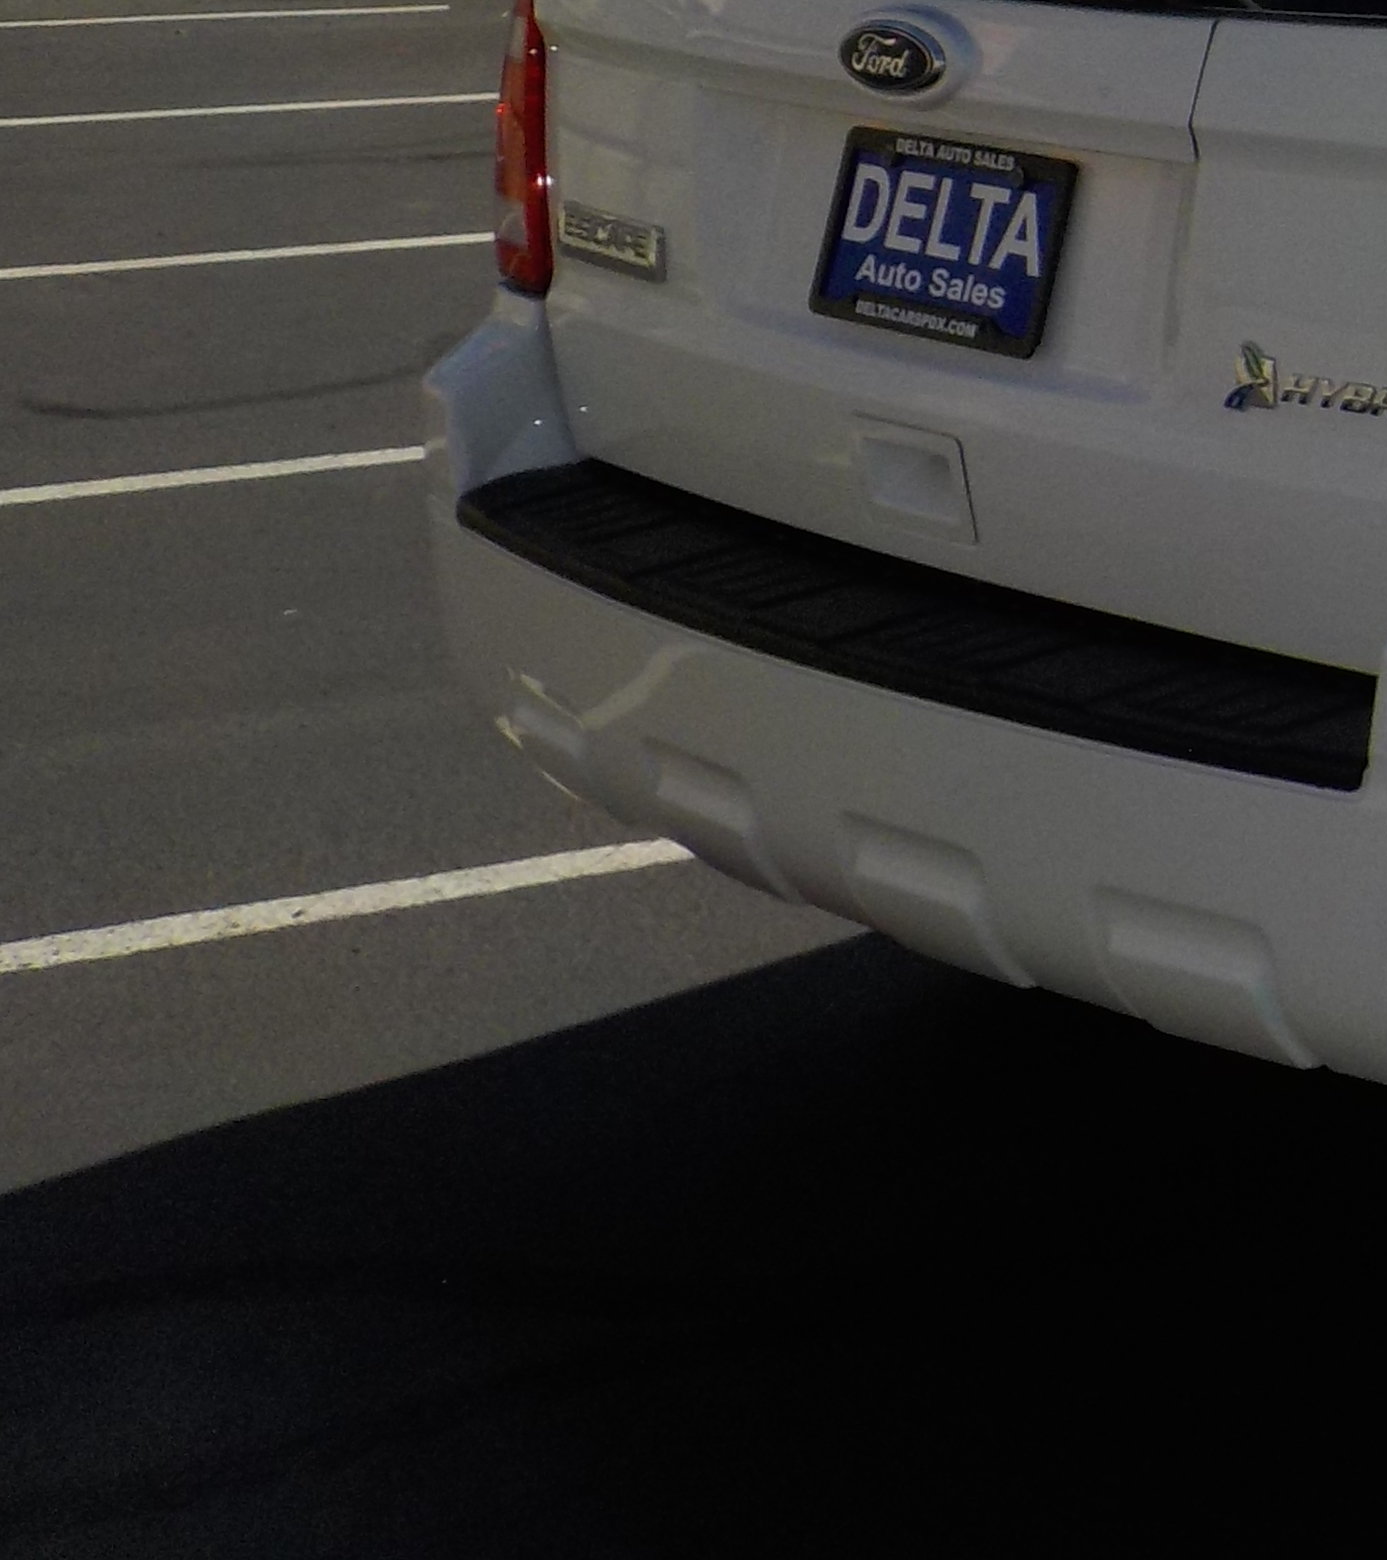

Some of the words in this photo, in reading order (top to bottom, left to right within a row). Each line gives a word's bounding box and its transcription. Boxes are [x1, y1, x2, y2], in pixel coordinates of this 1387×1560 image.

[850, 32, 911, 79] Ford
[895, 137, 935, 159] DELTA
[936, 144, 972, 165] AUTO
[973, 150, 1016, 172] SALES
[841, 162, 1041, 278] DELTA
[854, 253, 922, 292] Auto
[928, 267, 1006, 310] Sales
